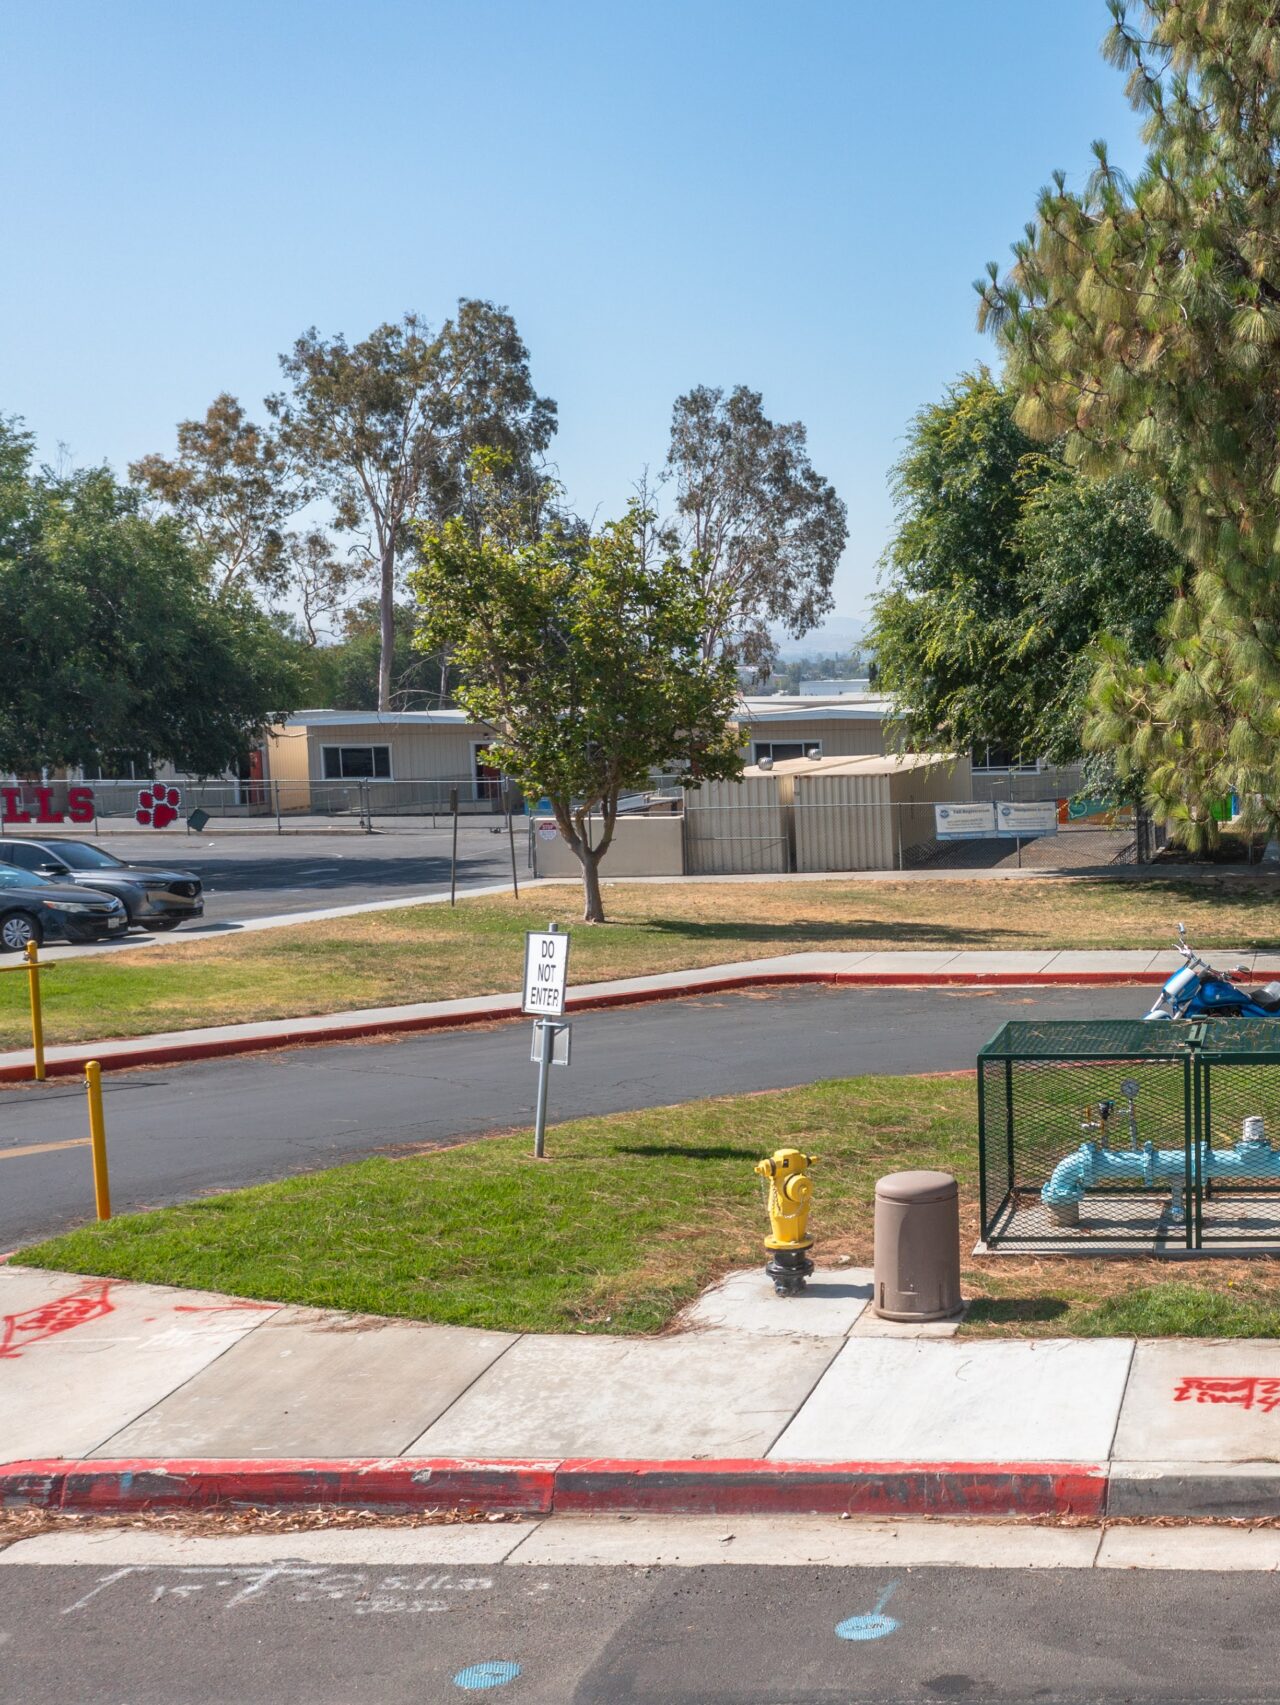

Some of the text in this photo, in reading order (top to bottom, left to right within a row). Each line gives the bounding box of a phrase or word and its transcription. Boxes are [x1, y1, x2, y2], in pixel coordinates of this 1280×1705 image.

[541, 940, 555, 958] DO
[537, 963, 557, 982] NOT
[530, 986, 560, 1007] ENTER
